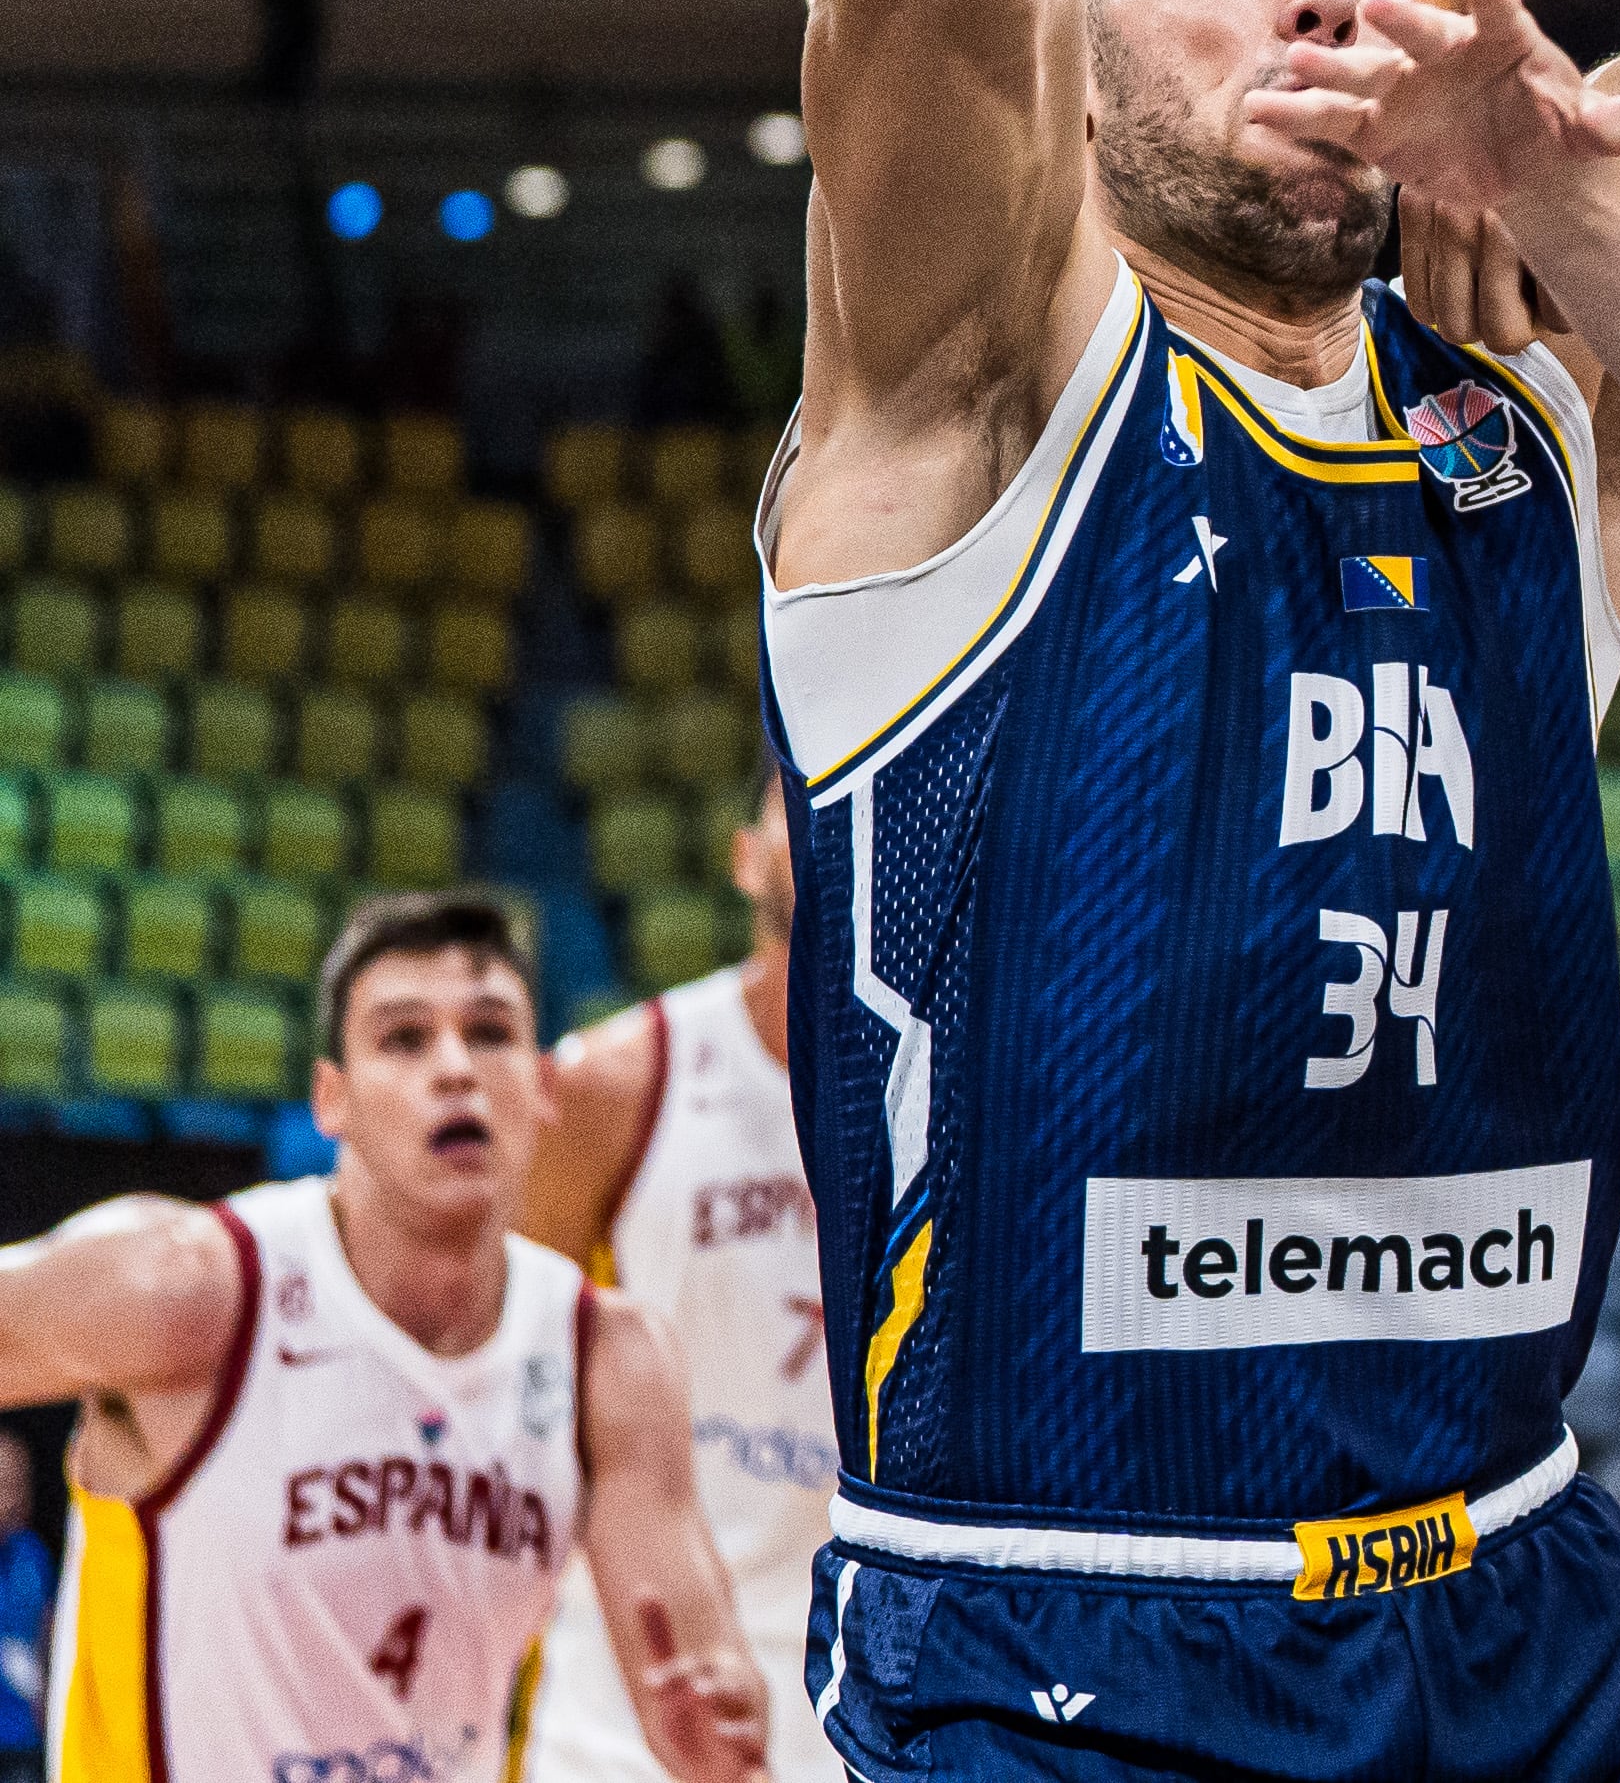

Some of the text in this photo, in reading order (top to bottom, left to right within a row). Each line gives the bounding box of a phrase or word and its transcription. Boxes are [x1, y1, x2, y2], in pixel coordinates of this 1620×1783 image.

[1303, 908, 1449, 1089] 34
[1141, 1208, 1555, 1300] telemach
[370, 1604, 431, 1701] 4
